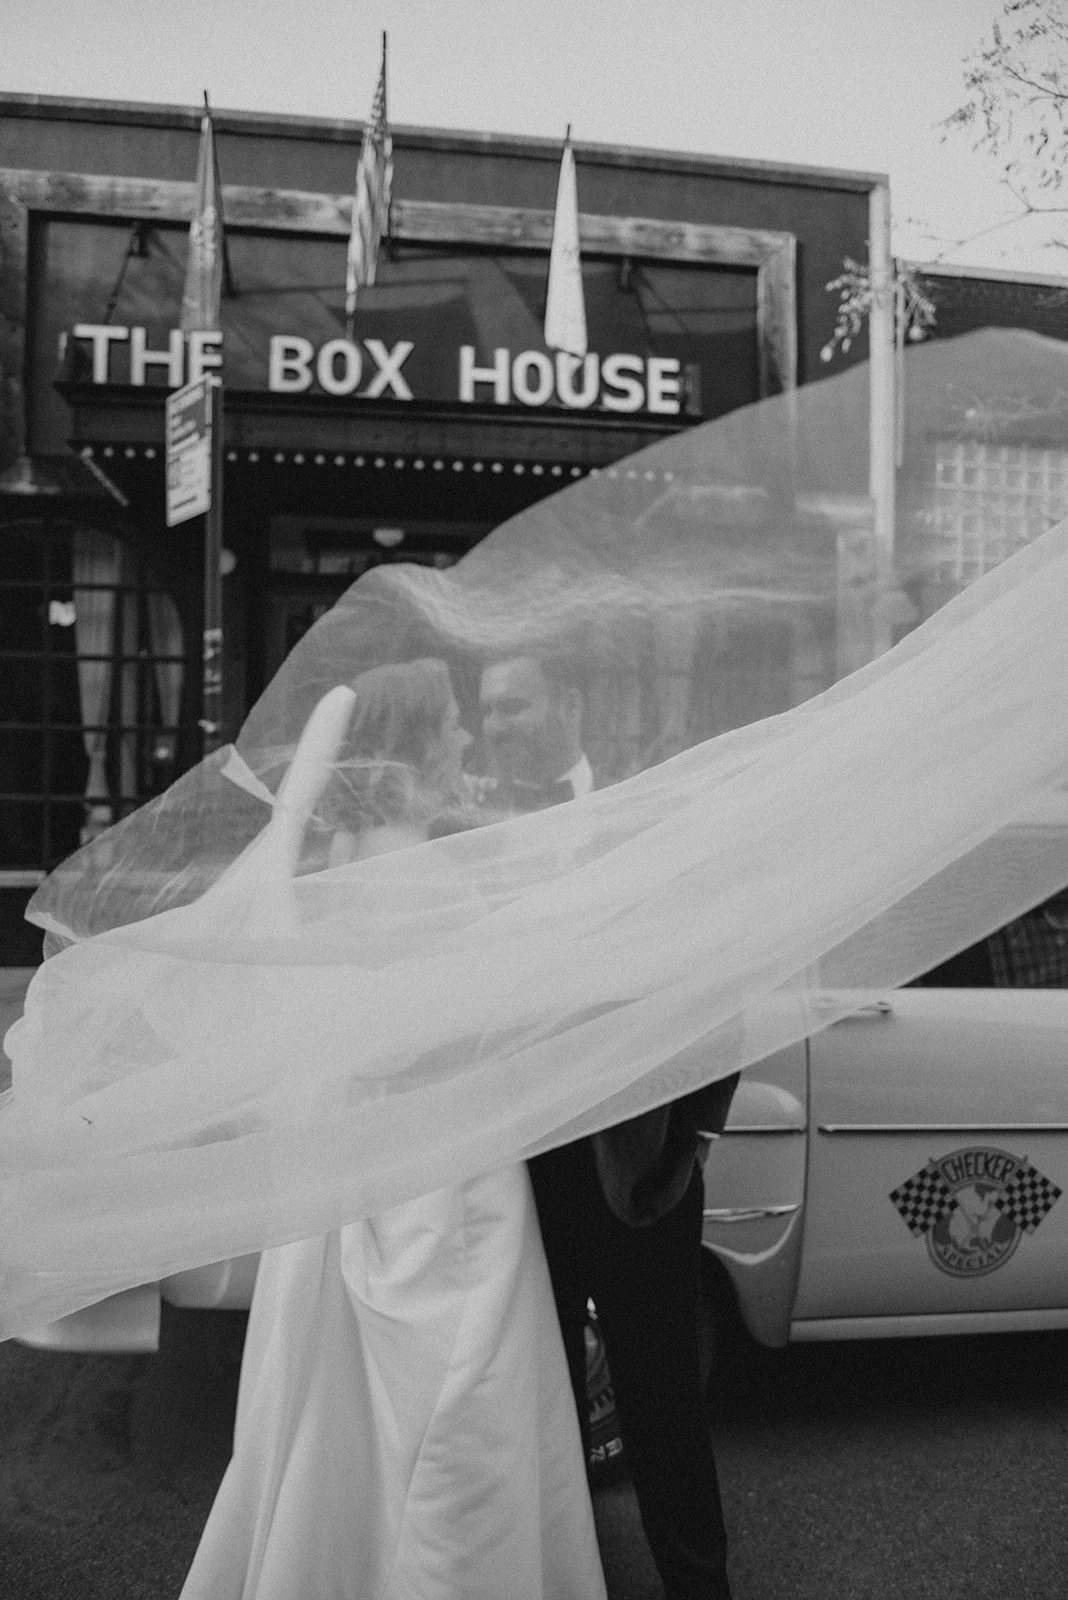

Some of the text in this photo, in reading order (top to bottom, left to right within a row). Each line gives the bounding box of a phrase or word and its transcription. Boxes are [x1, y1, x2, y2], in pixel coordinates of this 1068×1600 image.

[74, 324, 681, 415] THE BOX HOUSE
[942, 1152, 1015, 1183] CHECKER
